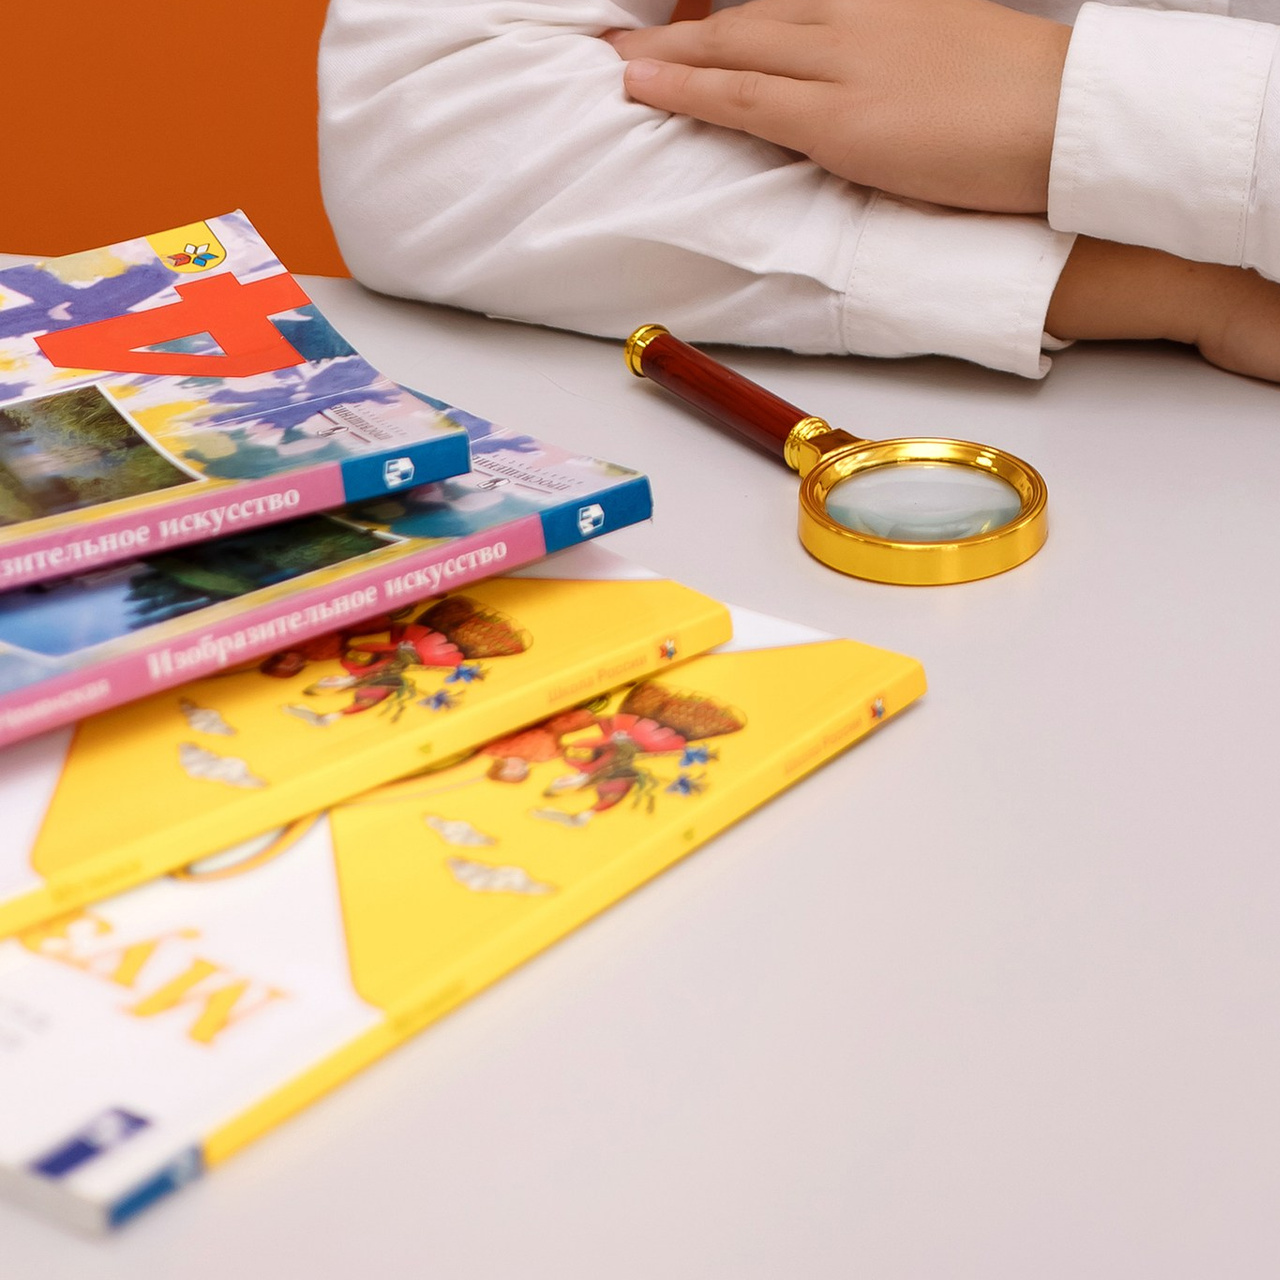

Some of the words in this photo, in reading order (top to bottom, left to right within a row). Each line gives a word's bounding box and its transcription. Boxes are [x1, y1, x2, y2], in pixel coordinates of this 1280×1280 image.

[34, 272, 312, 377] 4
[158, 488, 300, 537] искусство
[146, 583, 378, 680] Изобразительное
[384, 540, 508, 598] искусство
